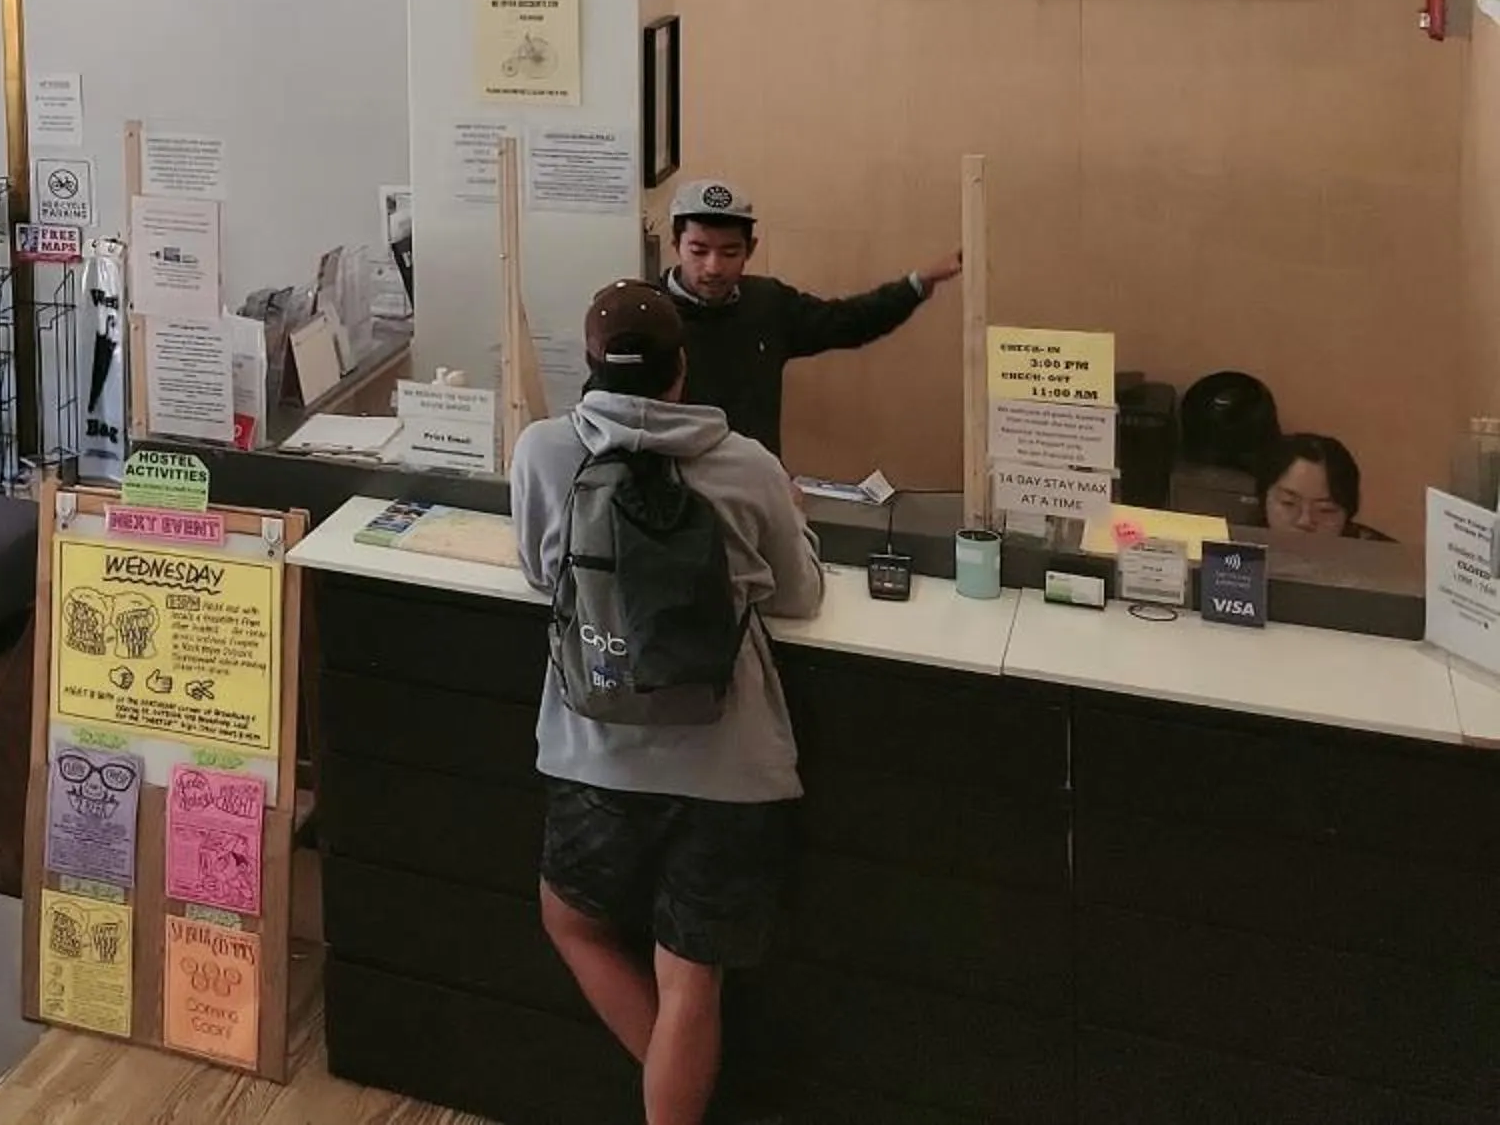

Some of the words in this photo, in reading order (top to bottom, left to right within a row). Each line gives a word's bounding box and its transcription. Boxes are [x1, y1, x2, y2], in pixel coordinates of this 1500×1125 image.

[41, 209, 88, 219] PARKING
[41, 228, 77, 241] FREE
[41, 241, 77, 252] MAPS
[1030, 358, 1061, 369] 3:00
[1064, 360, 1089, 370] PM
[1032, 387, 1071, 398] 11:00
[1074, 390, 1098, 399] AM
[86, 419, 119, 443] Bag
[139, 452, 197, 468] HOSTEL
[125, 465, 208, 482] ACTIVITIES
[999, 473, 1013, 483] 14
[1017, 474, 1041, 486] DAY
[1043, 478, 1076, 491] STAY
[1077, 483, 1107, 494] MAX
[1021, 494, 1037, 505] AT
[1041, 496, 1050, 507] A
[1053, 498, 1085, 510] TIME
[110, 511, 157, 532] NEXT
[161, 516, 220, 538] EVENT
[105, 554, 226, 587] WEDNESDAY
[1212, 598, 1256, 617] VISA
